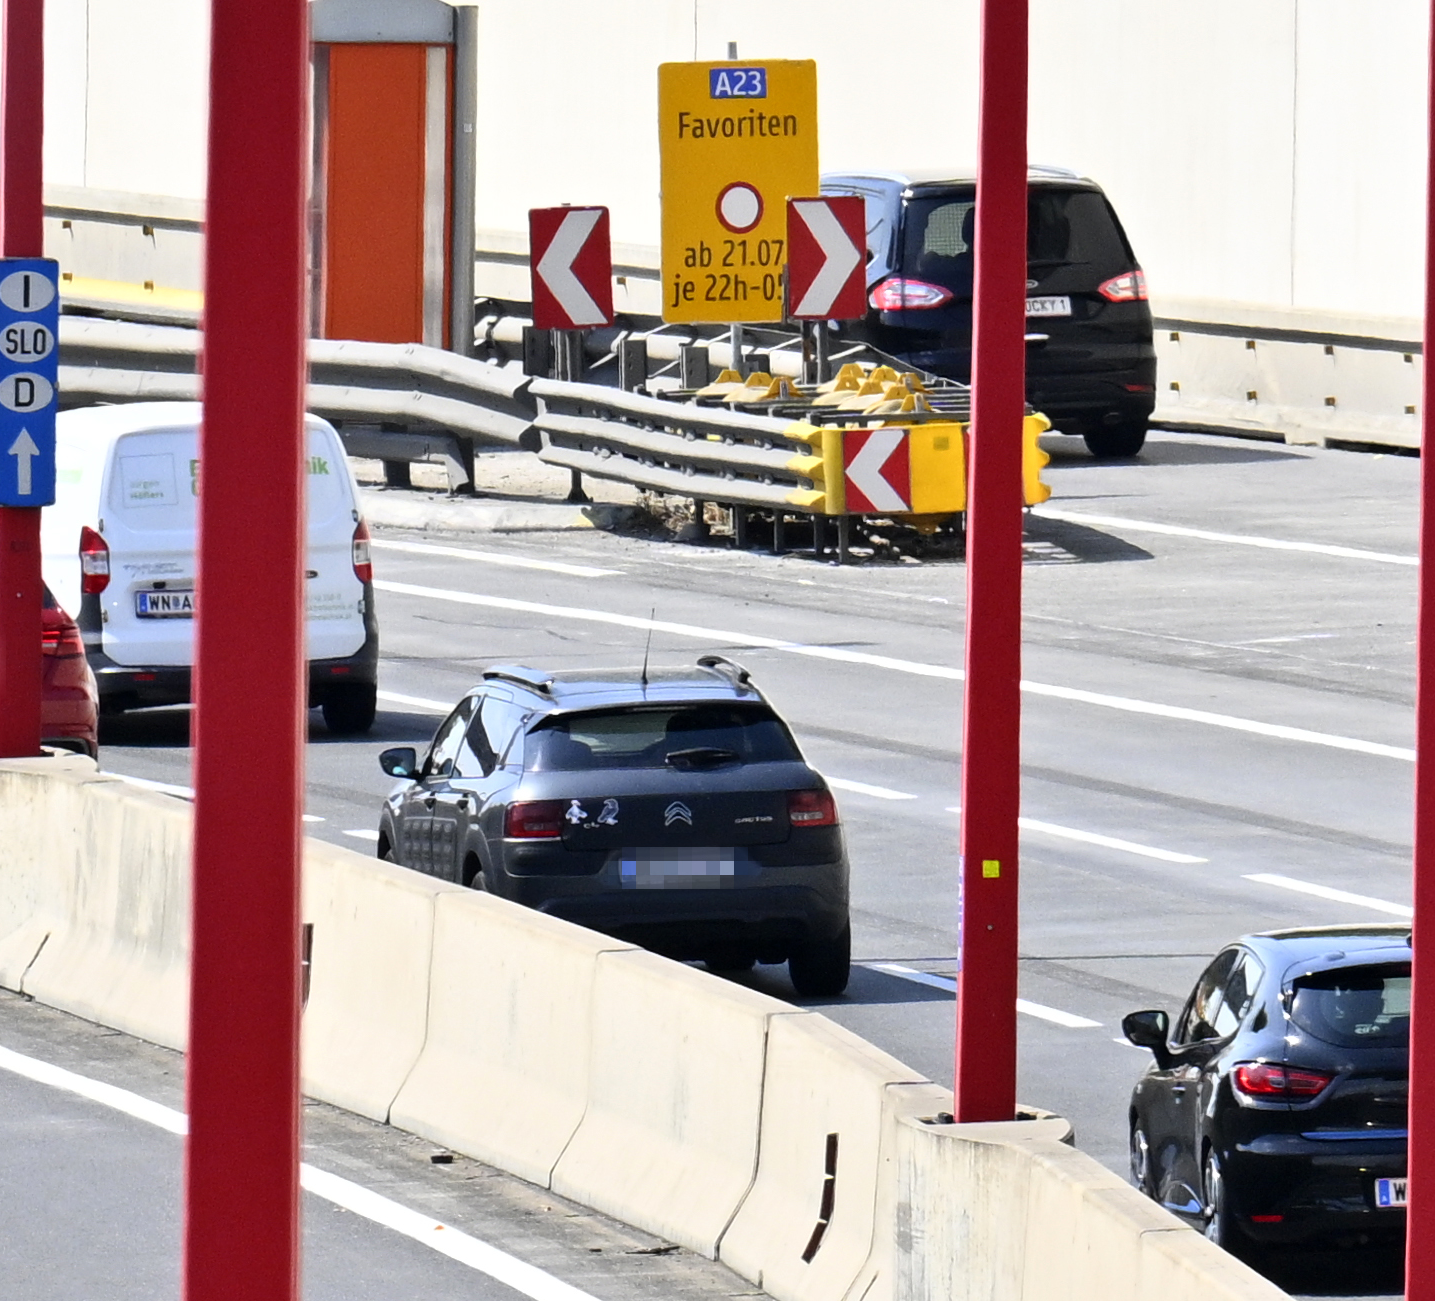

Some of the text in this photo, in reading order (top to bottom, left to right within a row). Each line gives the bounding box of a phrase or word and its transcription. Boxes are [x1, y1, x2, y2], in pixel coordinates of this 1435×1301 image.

[715, 71, 762, 96] A23
[678, 108, 797, 139] Favoriten
[684, 241, 712, 268] ab
[671, 274, 695, 308] je
[5, 328, 46, 356] SLO
[14, 377, 35, 408] D
[149, 595, 171, 611] WN
